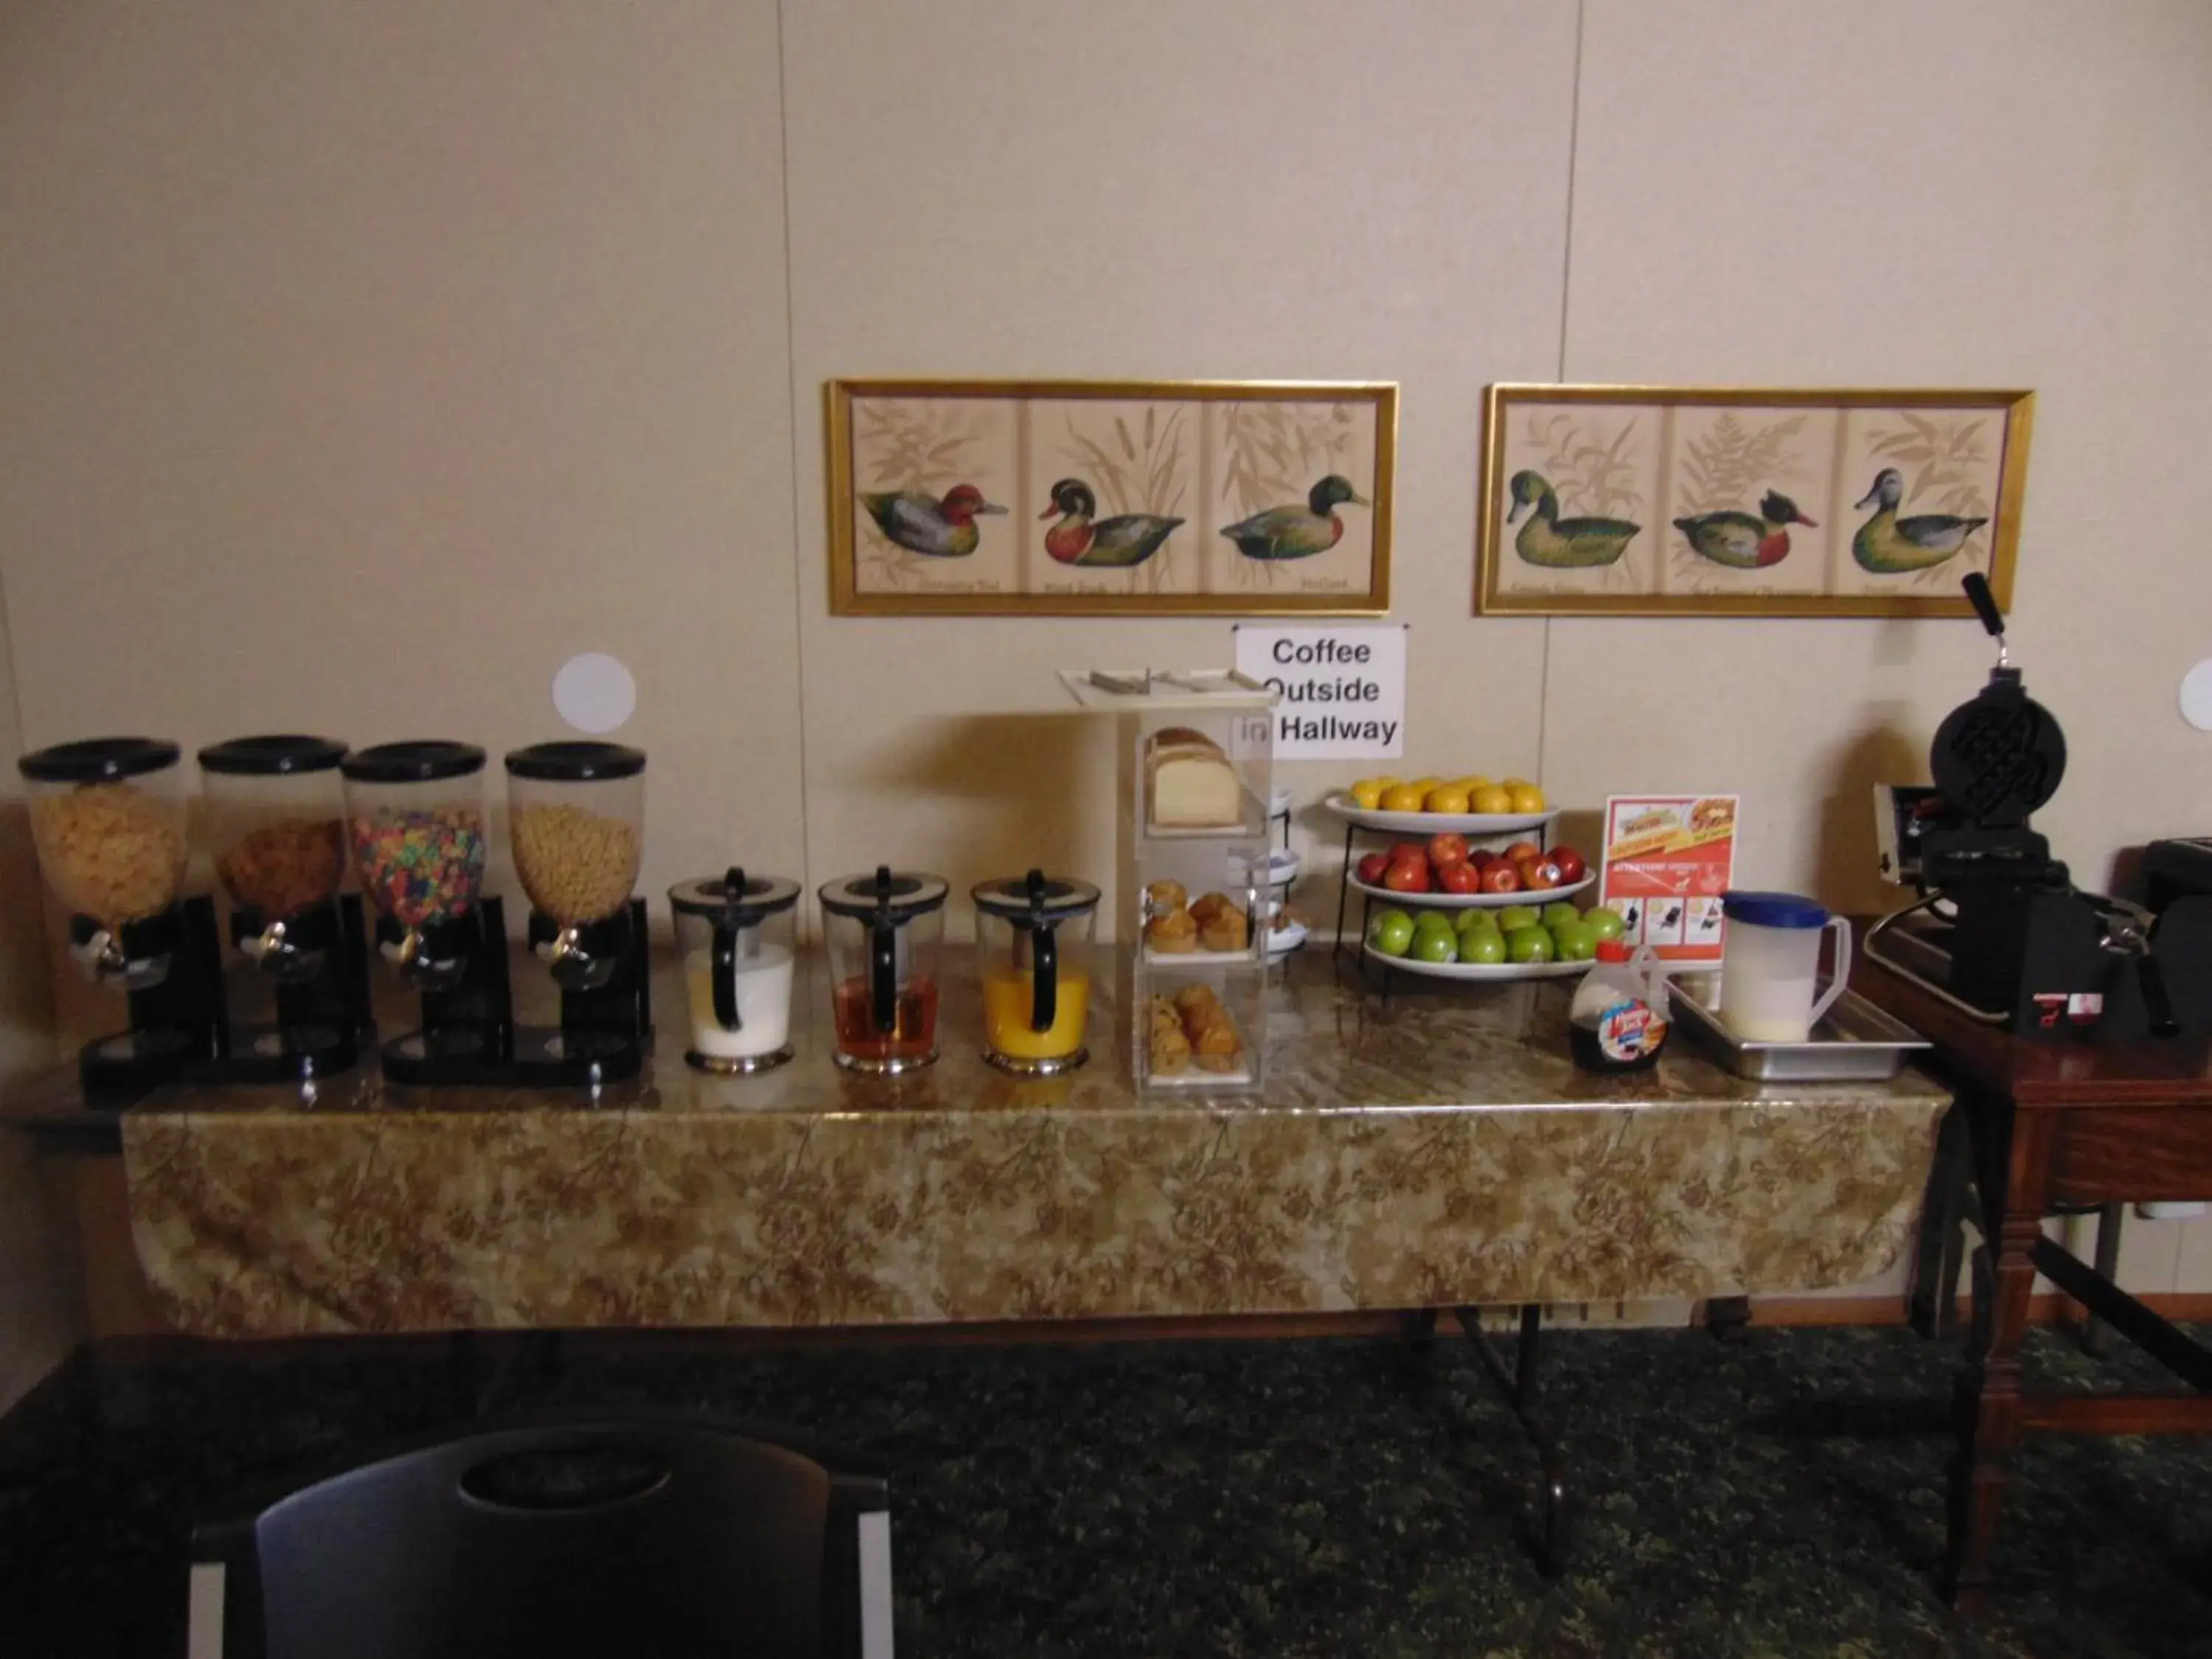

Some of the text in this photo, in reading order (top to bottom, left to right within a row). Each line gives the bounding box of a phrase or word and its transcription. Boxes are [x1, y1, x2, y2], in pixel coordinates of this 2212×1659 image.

[1273, 639, 1371, 664] Coffee
[1242, 715, 1397, 746] in Hallway
